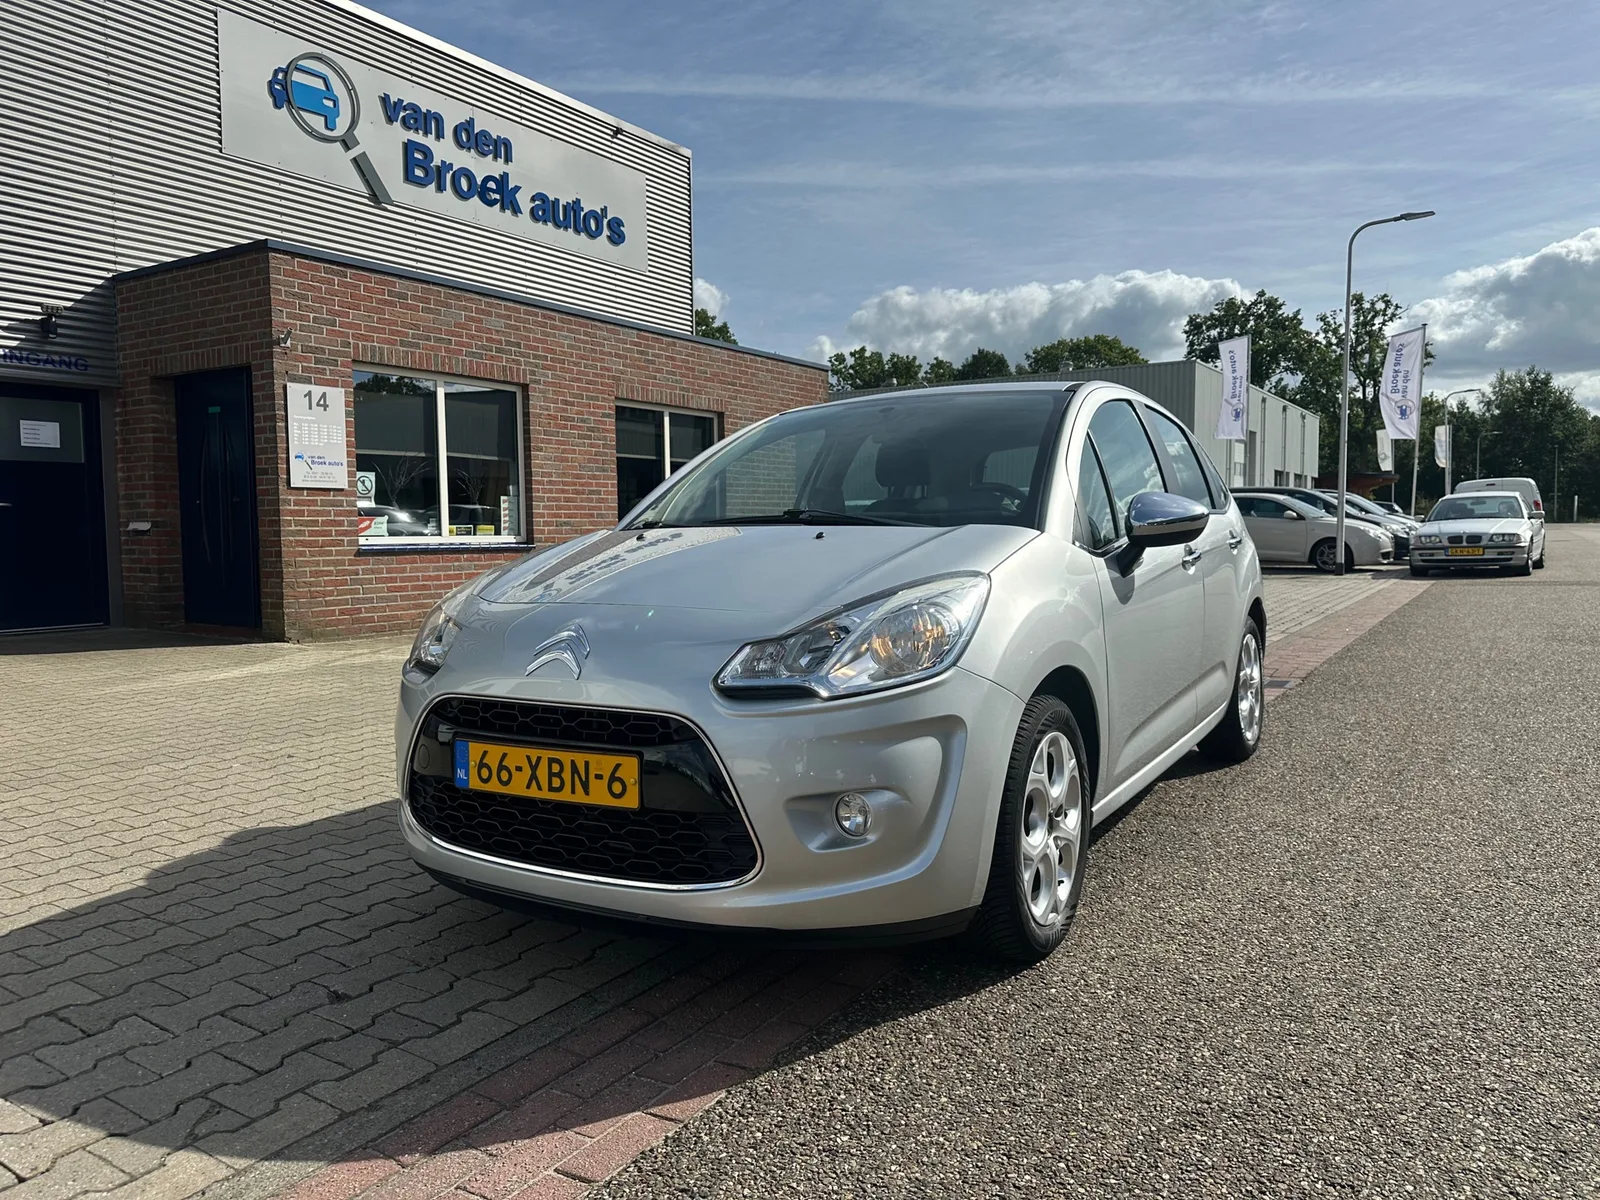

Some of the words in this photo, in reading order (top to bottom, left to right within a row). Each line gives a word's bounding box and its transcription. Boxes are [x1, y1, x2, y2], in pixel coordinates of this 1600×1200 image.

[381, 92, 445, 140] van
[454, 116, 513, 164] den
[402, 139, 522, 215] Broek
[530, 189, 626, 246] auto's
[303, 390, 329, 412] 14
[457, 768, 468, 780] NL
[477, 750, 628, 799] 66-XBN-6
